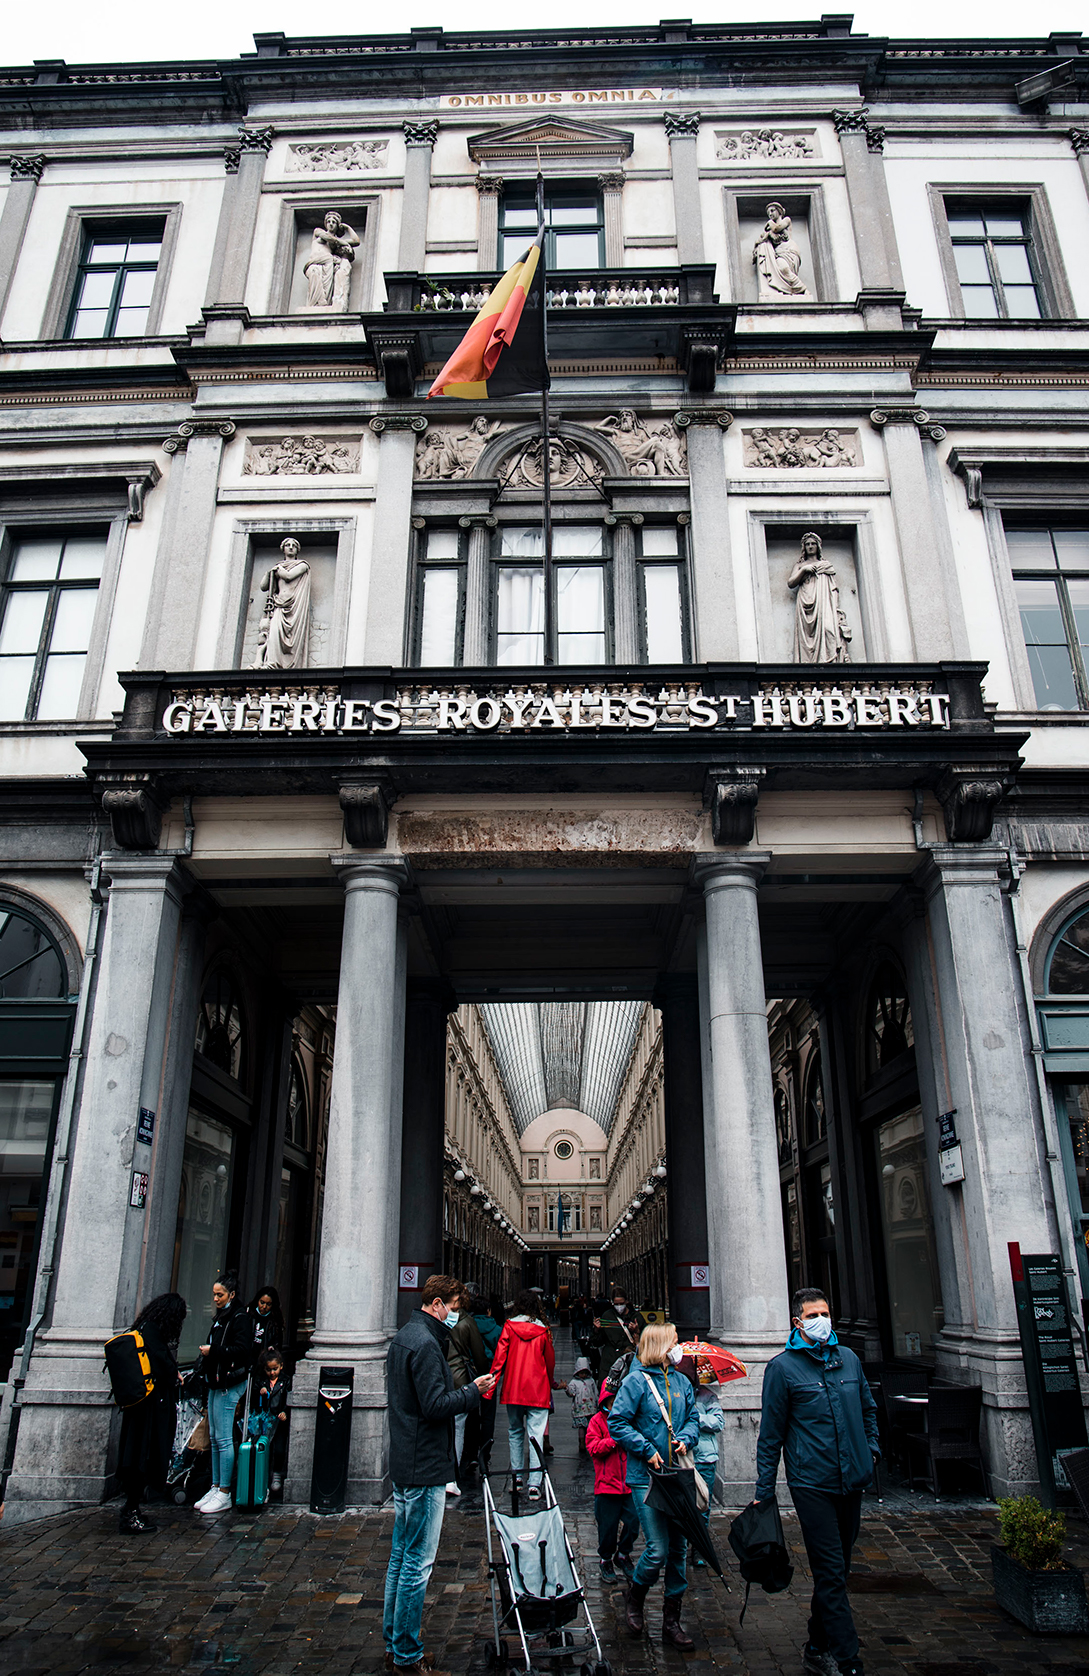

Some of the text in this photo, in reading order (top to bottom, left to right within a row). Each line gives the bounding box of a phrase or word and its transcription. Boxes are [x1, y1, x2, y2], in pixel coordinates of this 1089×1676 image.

[448, 89, 657, 107] OMNIBUS OMNIA
[162, 699, 401, 734] GALERIES
[437, 696, 658, 730] ROYALES
[750, 694, 951, 728] HUBERT
